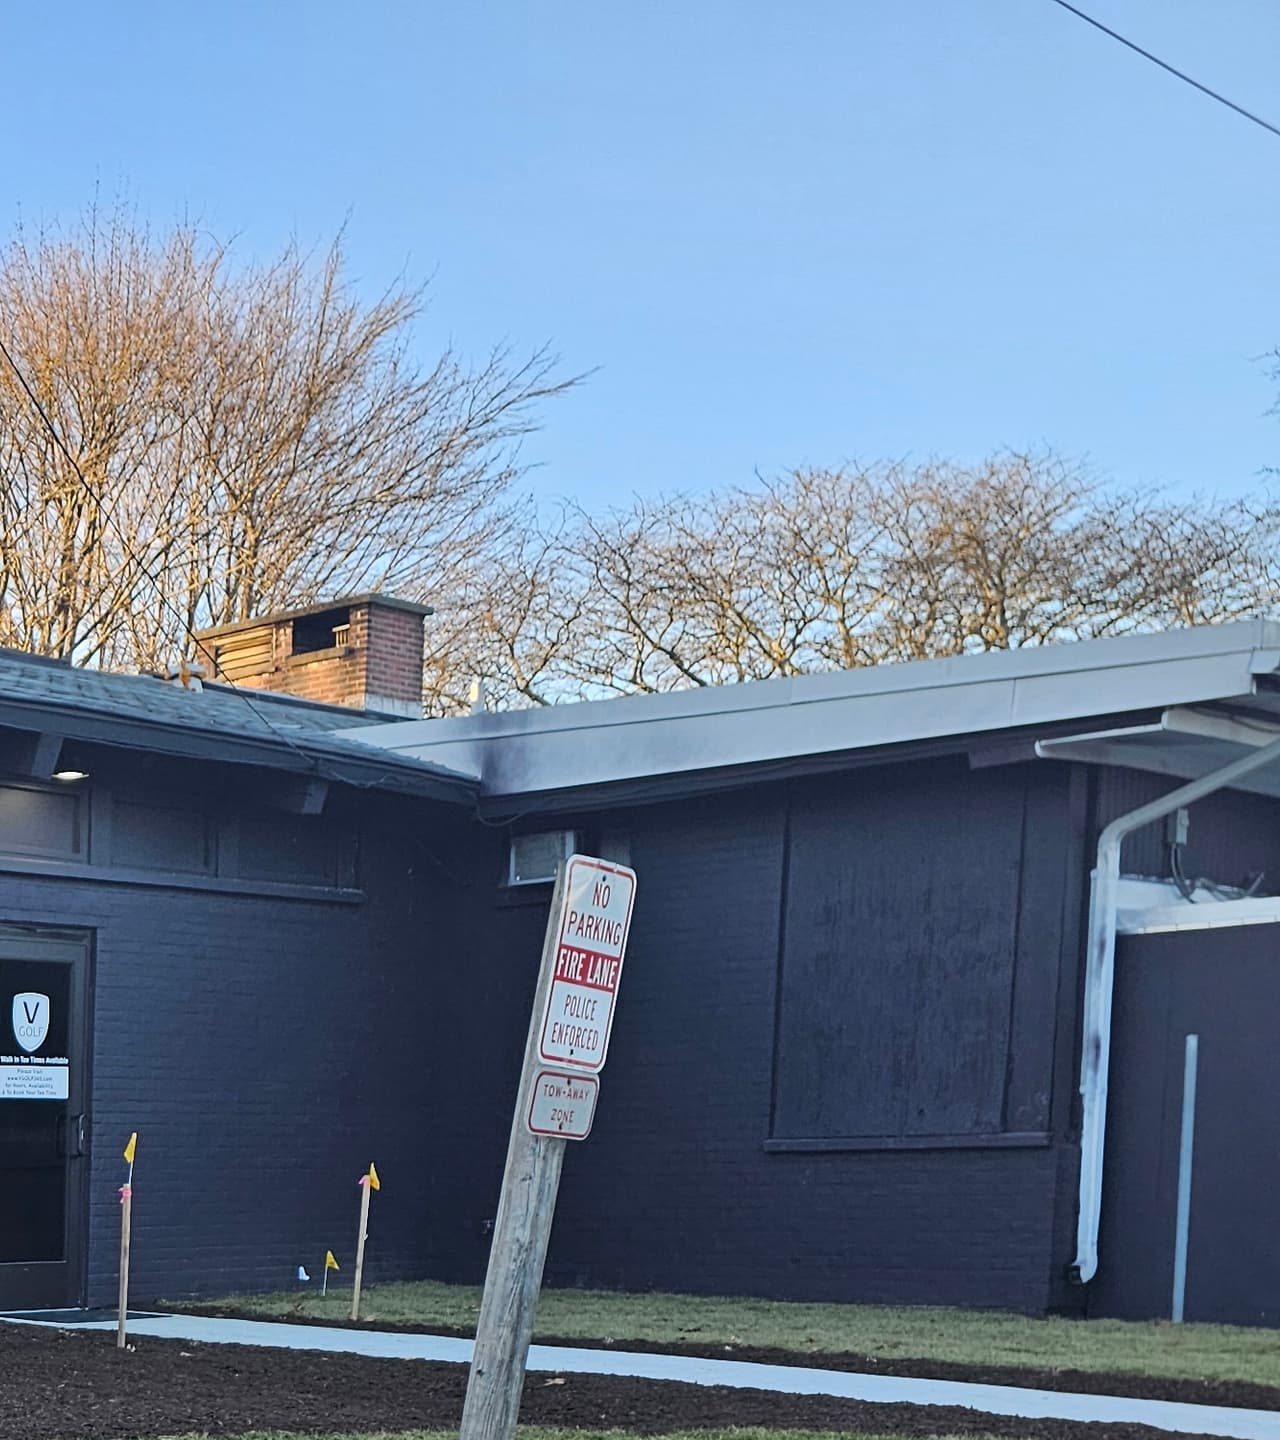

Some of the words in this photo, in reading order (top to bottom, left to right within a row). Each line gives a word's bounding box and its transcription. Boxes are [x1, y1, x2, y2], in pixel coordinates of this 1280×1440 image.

[592, 882, 611, 908] NO
[567, 910, 622, 946] PARKING
[556, 948, 586, 981] FIRE
[586, 955, 618, 989] LANE
[23, 1001, 40, 1024] V
[564, 994, 598, 1021] POLICE
[19, 1026, 44, 1038] GOLF
[551, 1022, 599, 1051] ENFORCED
[543, 1084, 590, 1101] TOW-AWAY
[551, 1108, 575, 1123] ZONE
